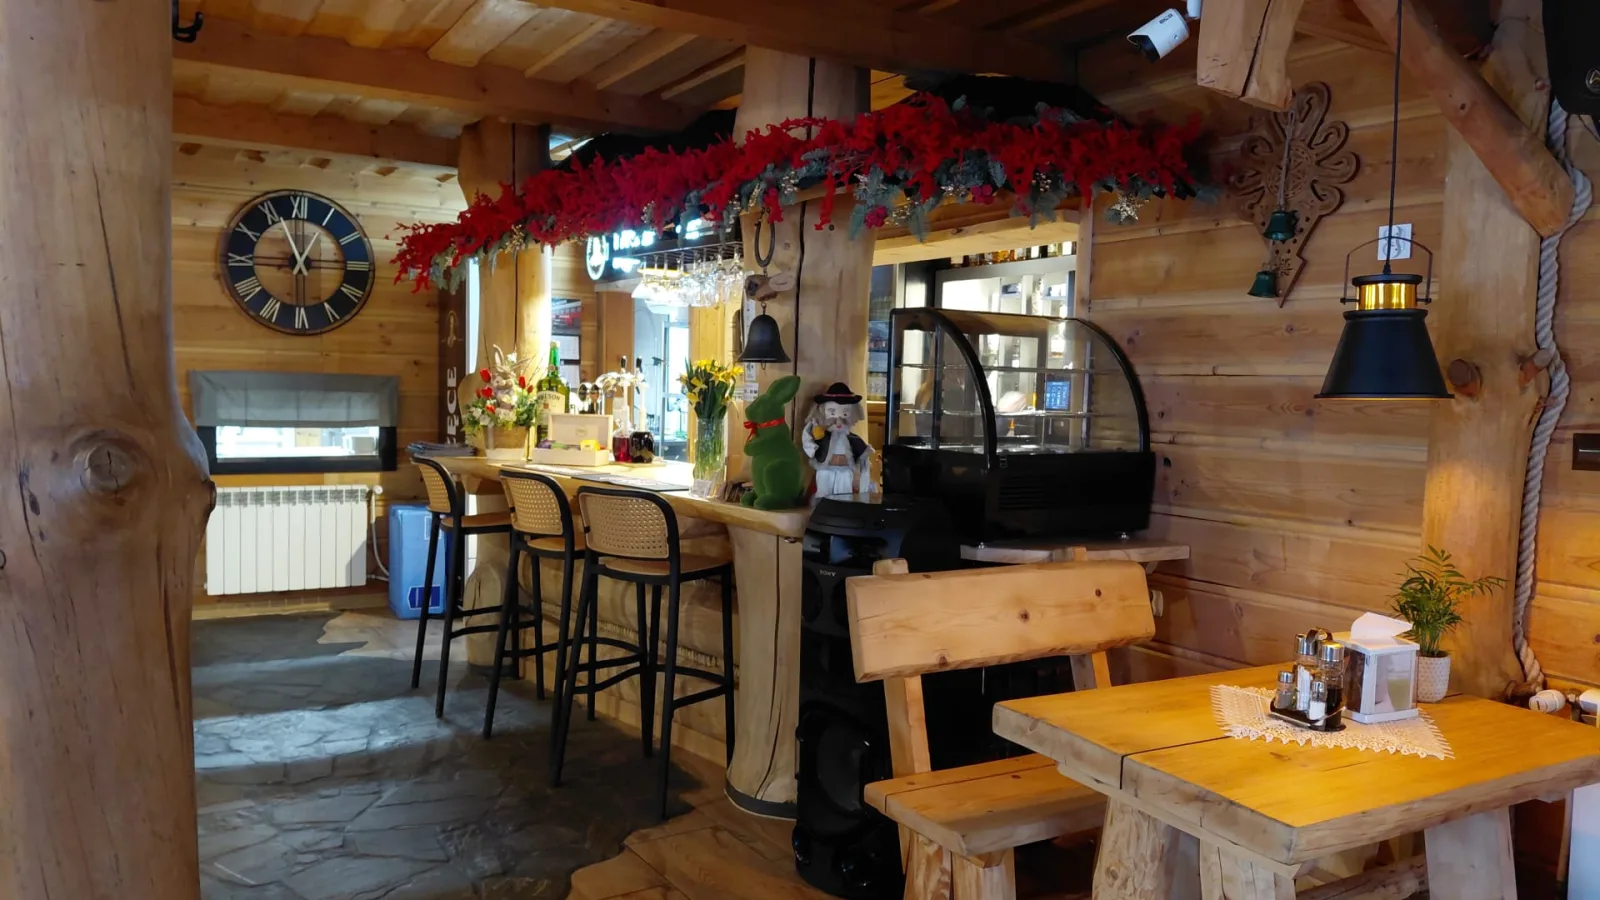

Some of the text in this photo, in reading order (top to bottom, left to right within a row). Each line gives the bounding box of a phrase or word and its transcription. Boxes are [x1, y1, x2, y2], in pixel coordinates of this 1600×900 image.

[258, 200, 280, 225] XI
[290, 196, 309, 219] XII
[235, 222, 260, 242] X
[339, 231, 361, 245] II
[346, 261, 370, 271] III
